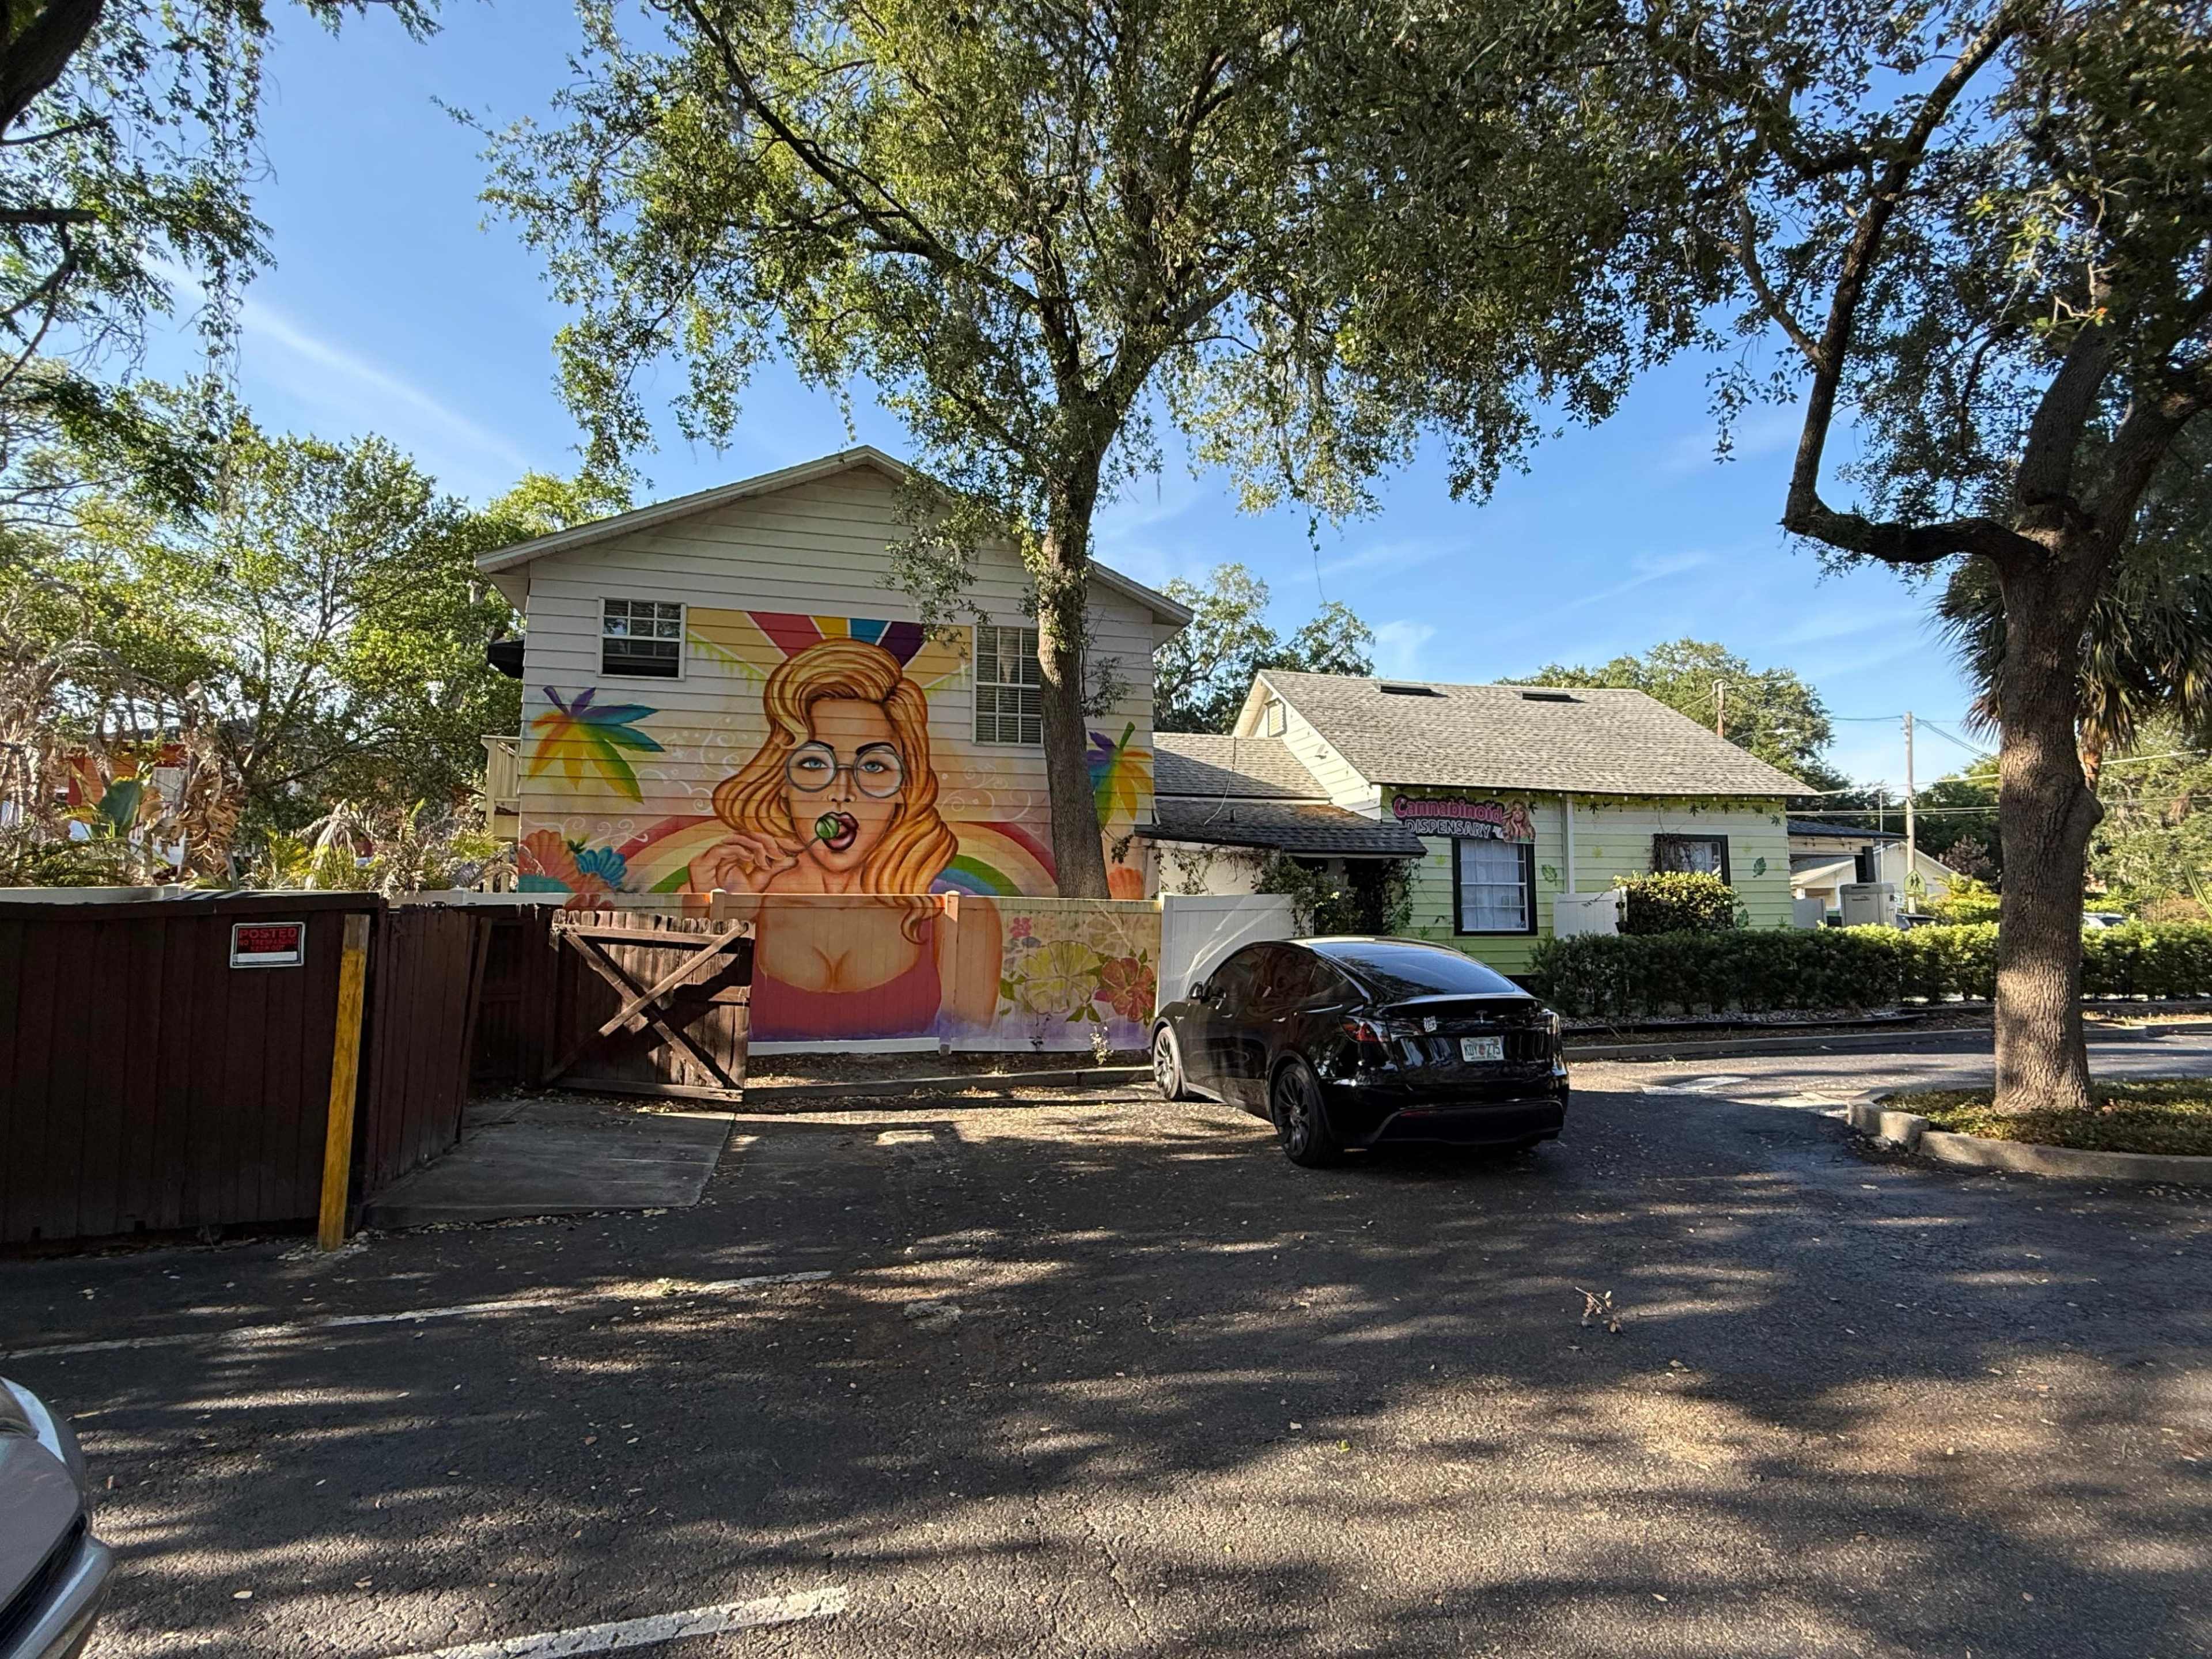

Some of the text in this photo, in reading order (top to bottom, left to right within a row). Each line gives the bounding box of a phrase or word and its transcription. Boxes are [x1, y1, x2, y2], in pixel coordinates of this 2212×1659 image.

[1393, 797, 1503, 824] Cannabinoid
[1406, 819, 1491, 838] DISPENSARY
[238, 927, 297, 938] POSTED
